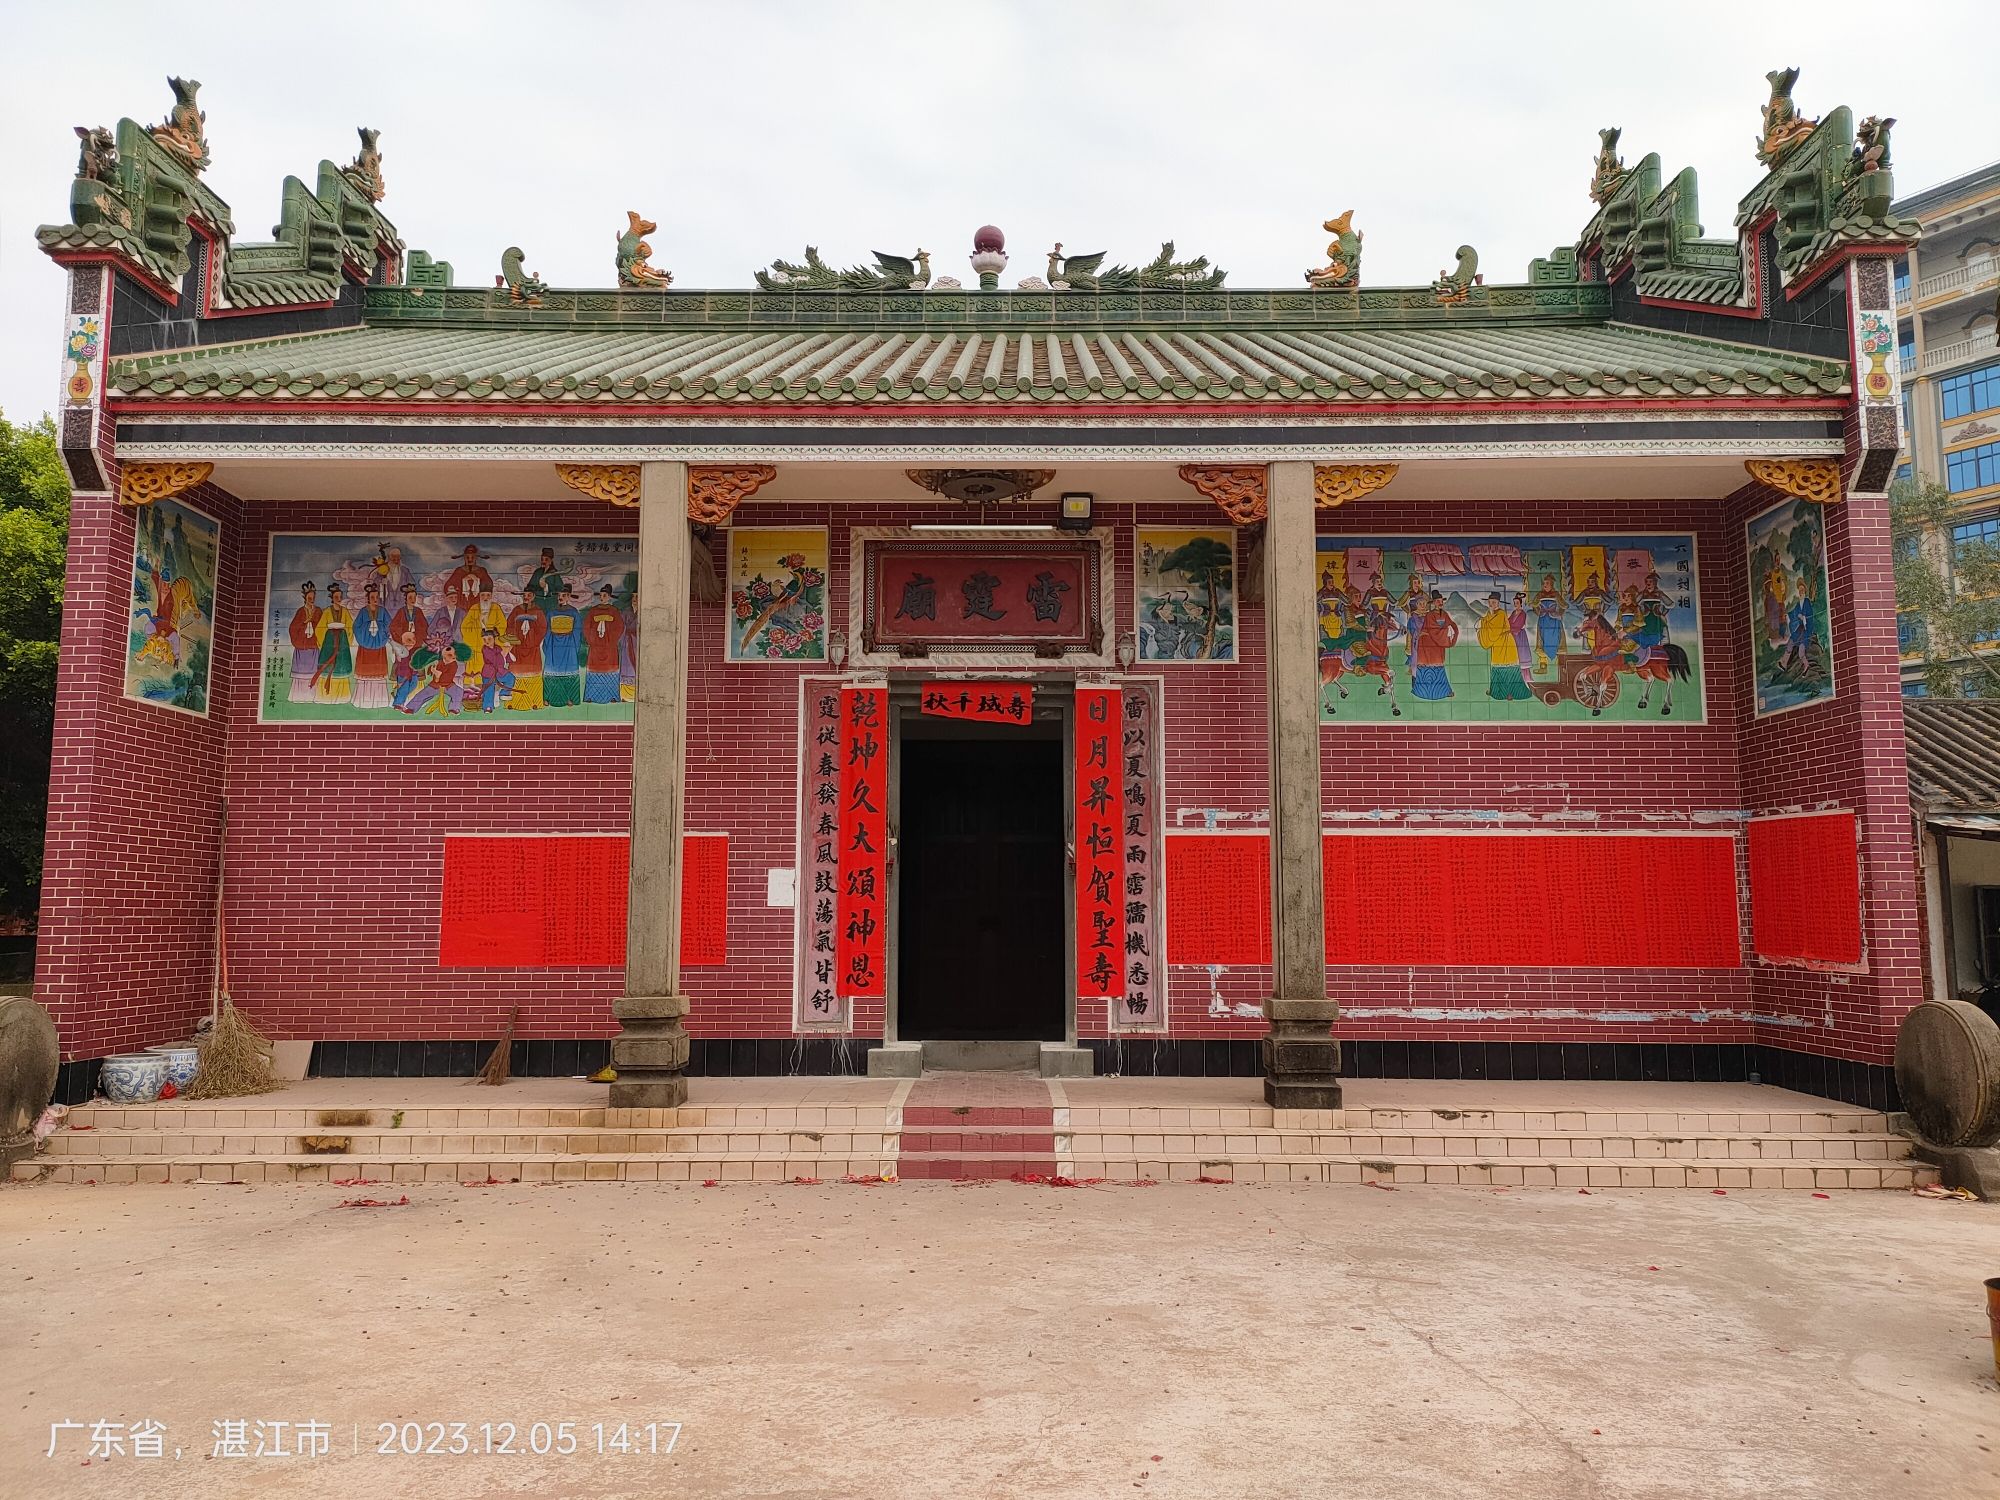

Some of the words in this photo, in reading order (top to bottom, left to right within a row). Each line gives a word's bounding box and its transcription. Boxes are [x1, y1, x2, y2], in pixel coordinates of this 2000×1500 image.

[894, 571, 1071, 623] 雷霆廟
[922, 691, 1030, 720] 壽域千秋
[846, 691, 880, 988] 乾坤久大頌神恩
